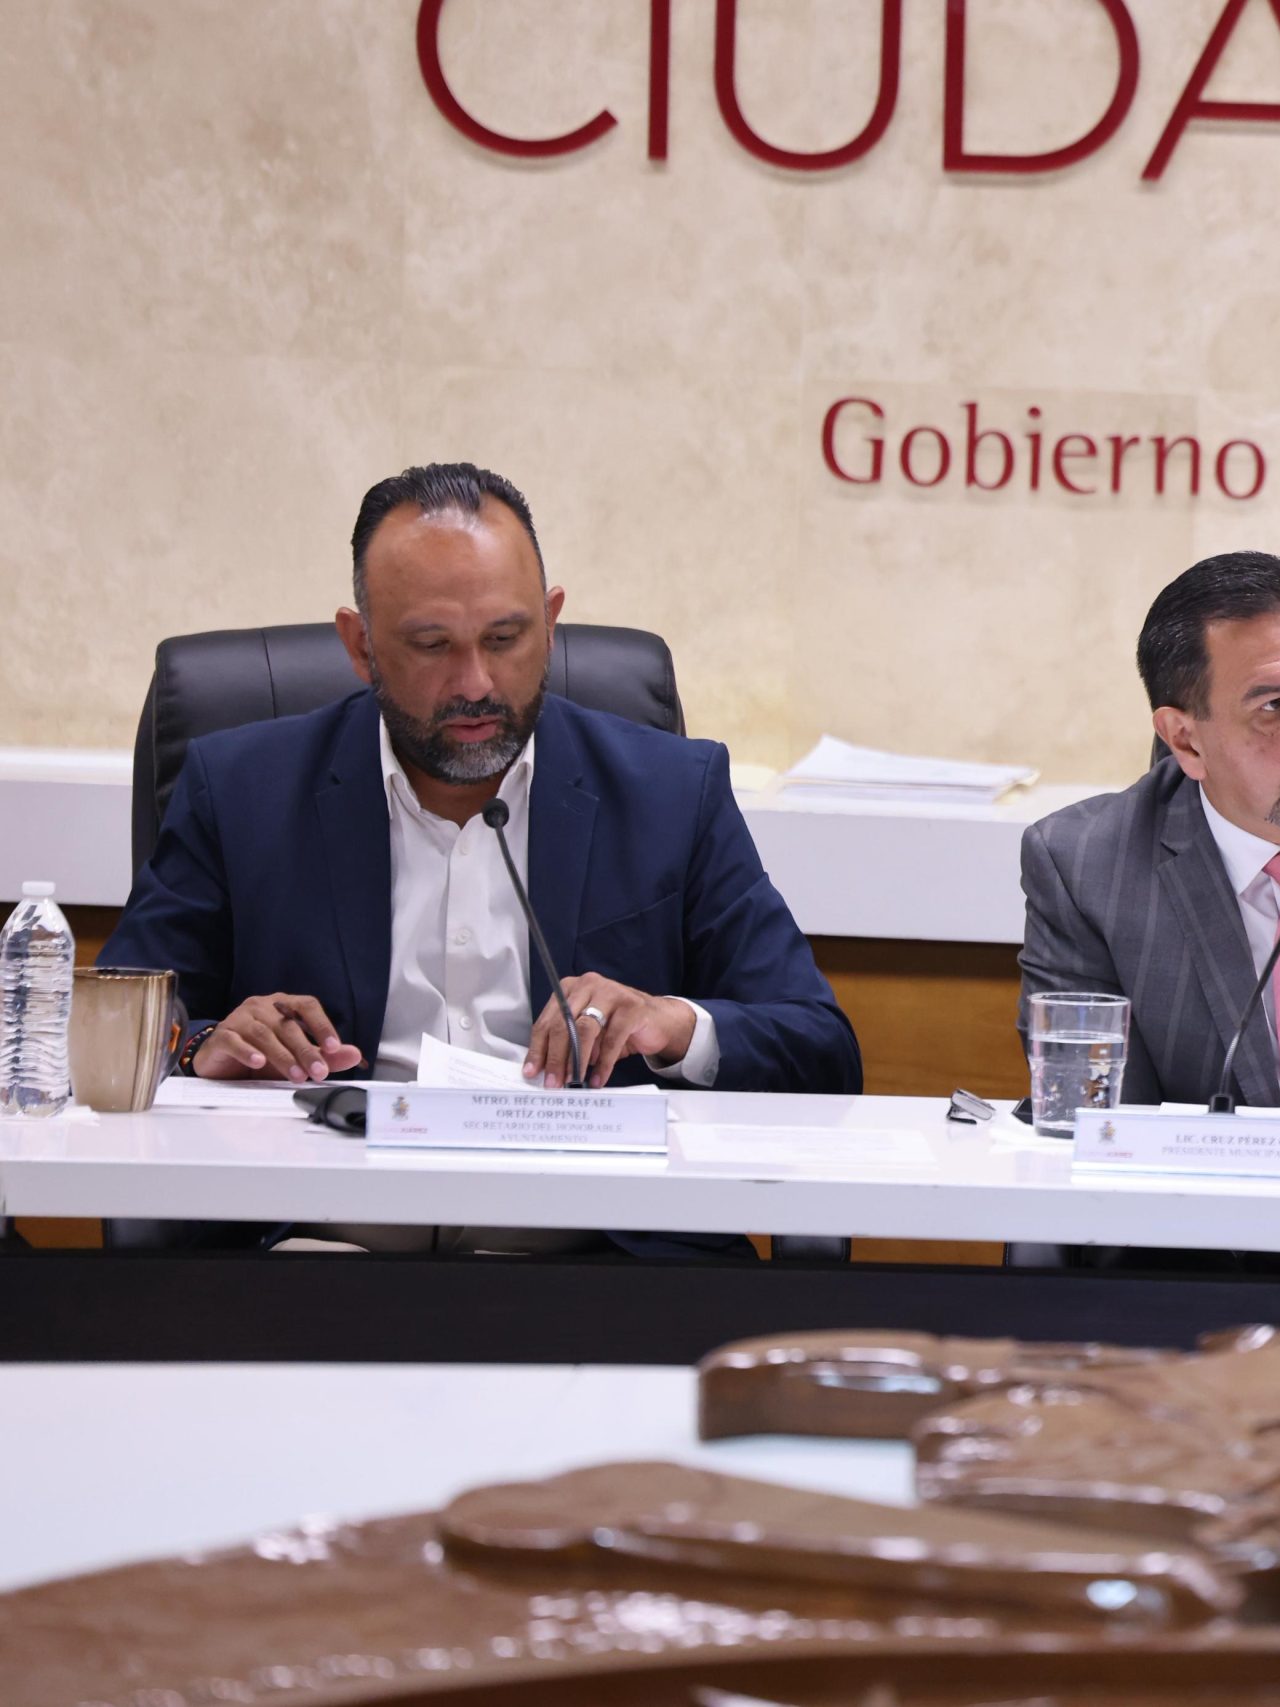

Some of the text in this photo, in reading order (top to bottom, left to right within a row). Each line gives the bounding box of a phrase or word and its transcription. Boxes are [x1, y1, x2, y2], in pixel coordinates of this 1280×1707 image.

[820, 397, 1268, 501] Gobierno
[472, 1094, 615, 1108] MTRO. HÉCTOR RAFAEL
[537, 1109, 590, 1121] ORPINEL
[463, 1121, 623, 1134] SECRETARIO DEL HONORABLE
[500, 1133, 588, 1144] AYUNTAMIENTO
[1175, 1134, 1198, 1144] LIC.
[1201, 1135, 1235, 1145] CRUZ
[1161, 1146, 1226, 1157] PRESIDENTE
